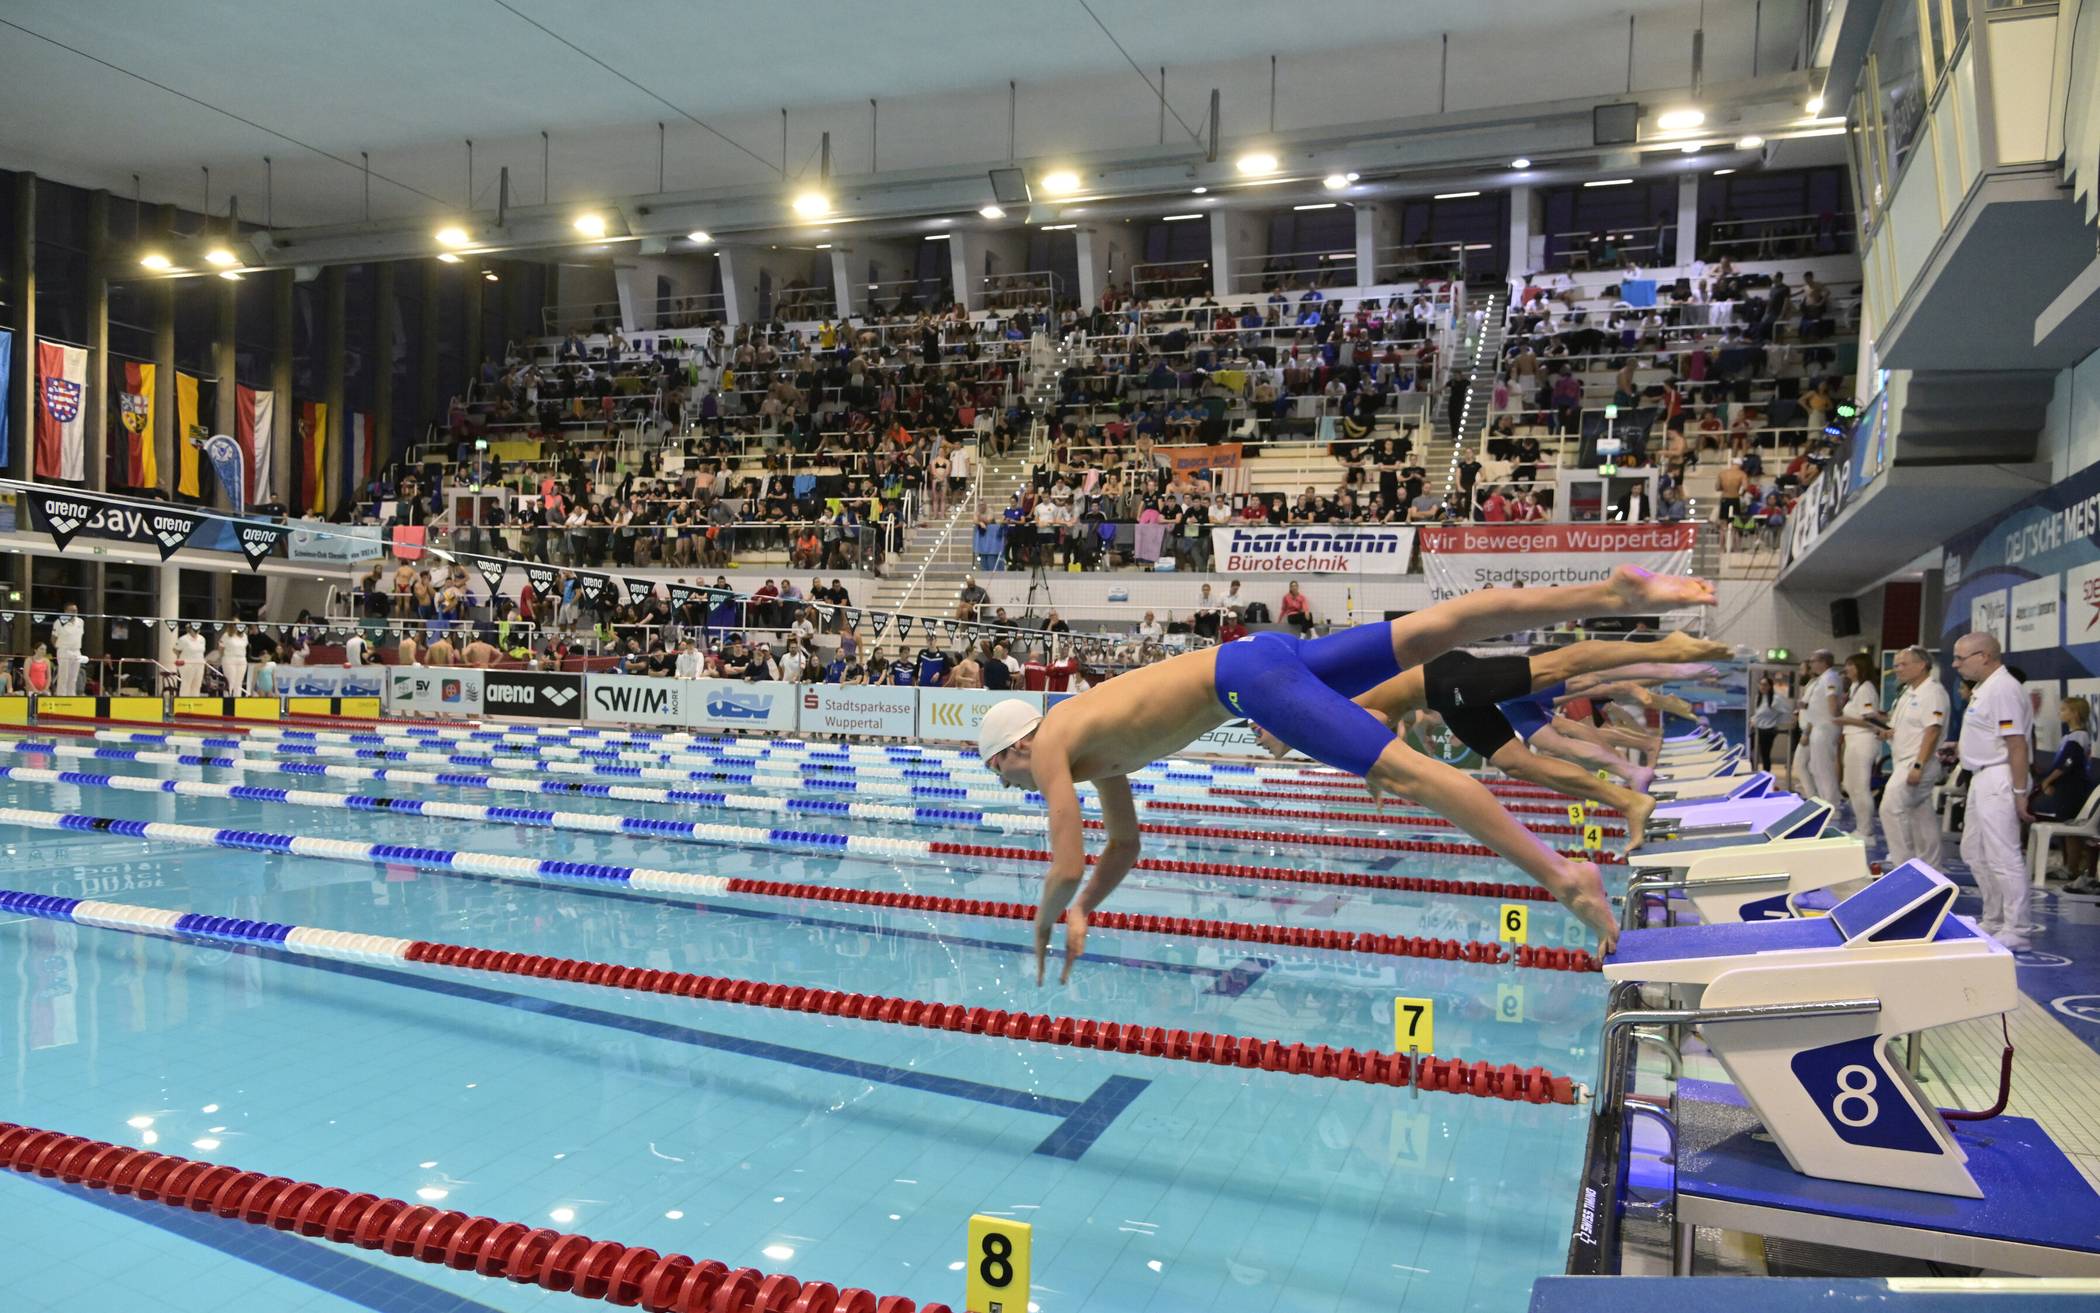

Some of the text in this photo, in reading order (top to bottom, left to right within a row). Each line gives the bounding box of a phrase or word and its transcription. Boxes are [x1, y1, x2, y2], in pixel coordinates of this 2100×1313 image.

[45, 500, 88, 519] arena
[153, 516, 190, 533] arena
[243, 528, 277, 543] arena
[1231, 529, 1398, 553] hartmann
[1423, 530, 1679, 551] Wir bewegen Wuppertal
[2005, 512, 2063, 565] DEUTSCHE
[478, 560, 501, 573] arena
[1227, 555, 1348, 571] Bürotechnik
[530, 569, 552, 581] arena
[1475, 568, 1610, 583] Stadtsportbund
[416, 680, 430, 691] SV
[486, 684, 535, 704] arena
[594, 686, 667, 713] SWIM
[825, 699, 911, 715] Stadtsparkasse
[825, 716, 883, 730] Wuppertal
[1571, 807, 1580, 818] 3
[1587, 829, 1597, 842] 4
[1506, 910, 1521, 931] 6
[1403, 1005, 1424, 1037] 7
[1832, 1064, 1879, 1128] 8
[980, 1232, 1013, 1288] 8
